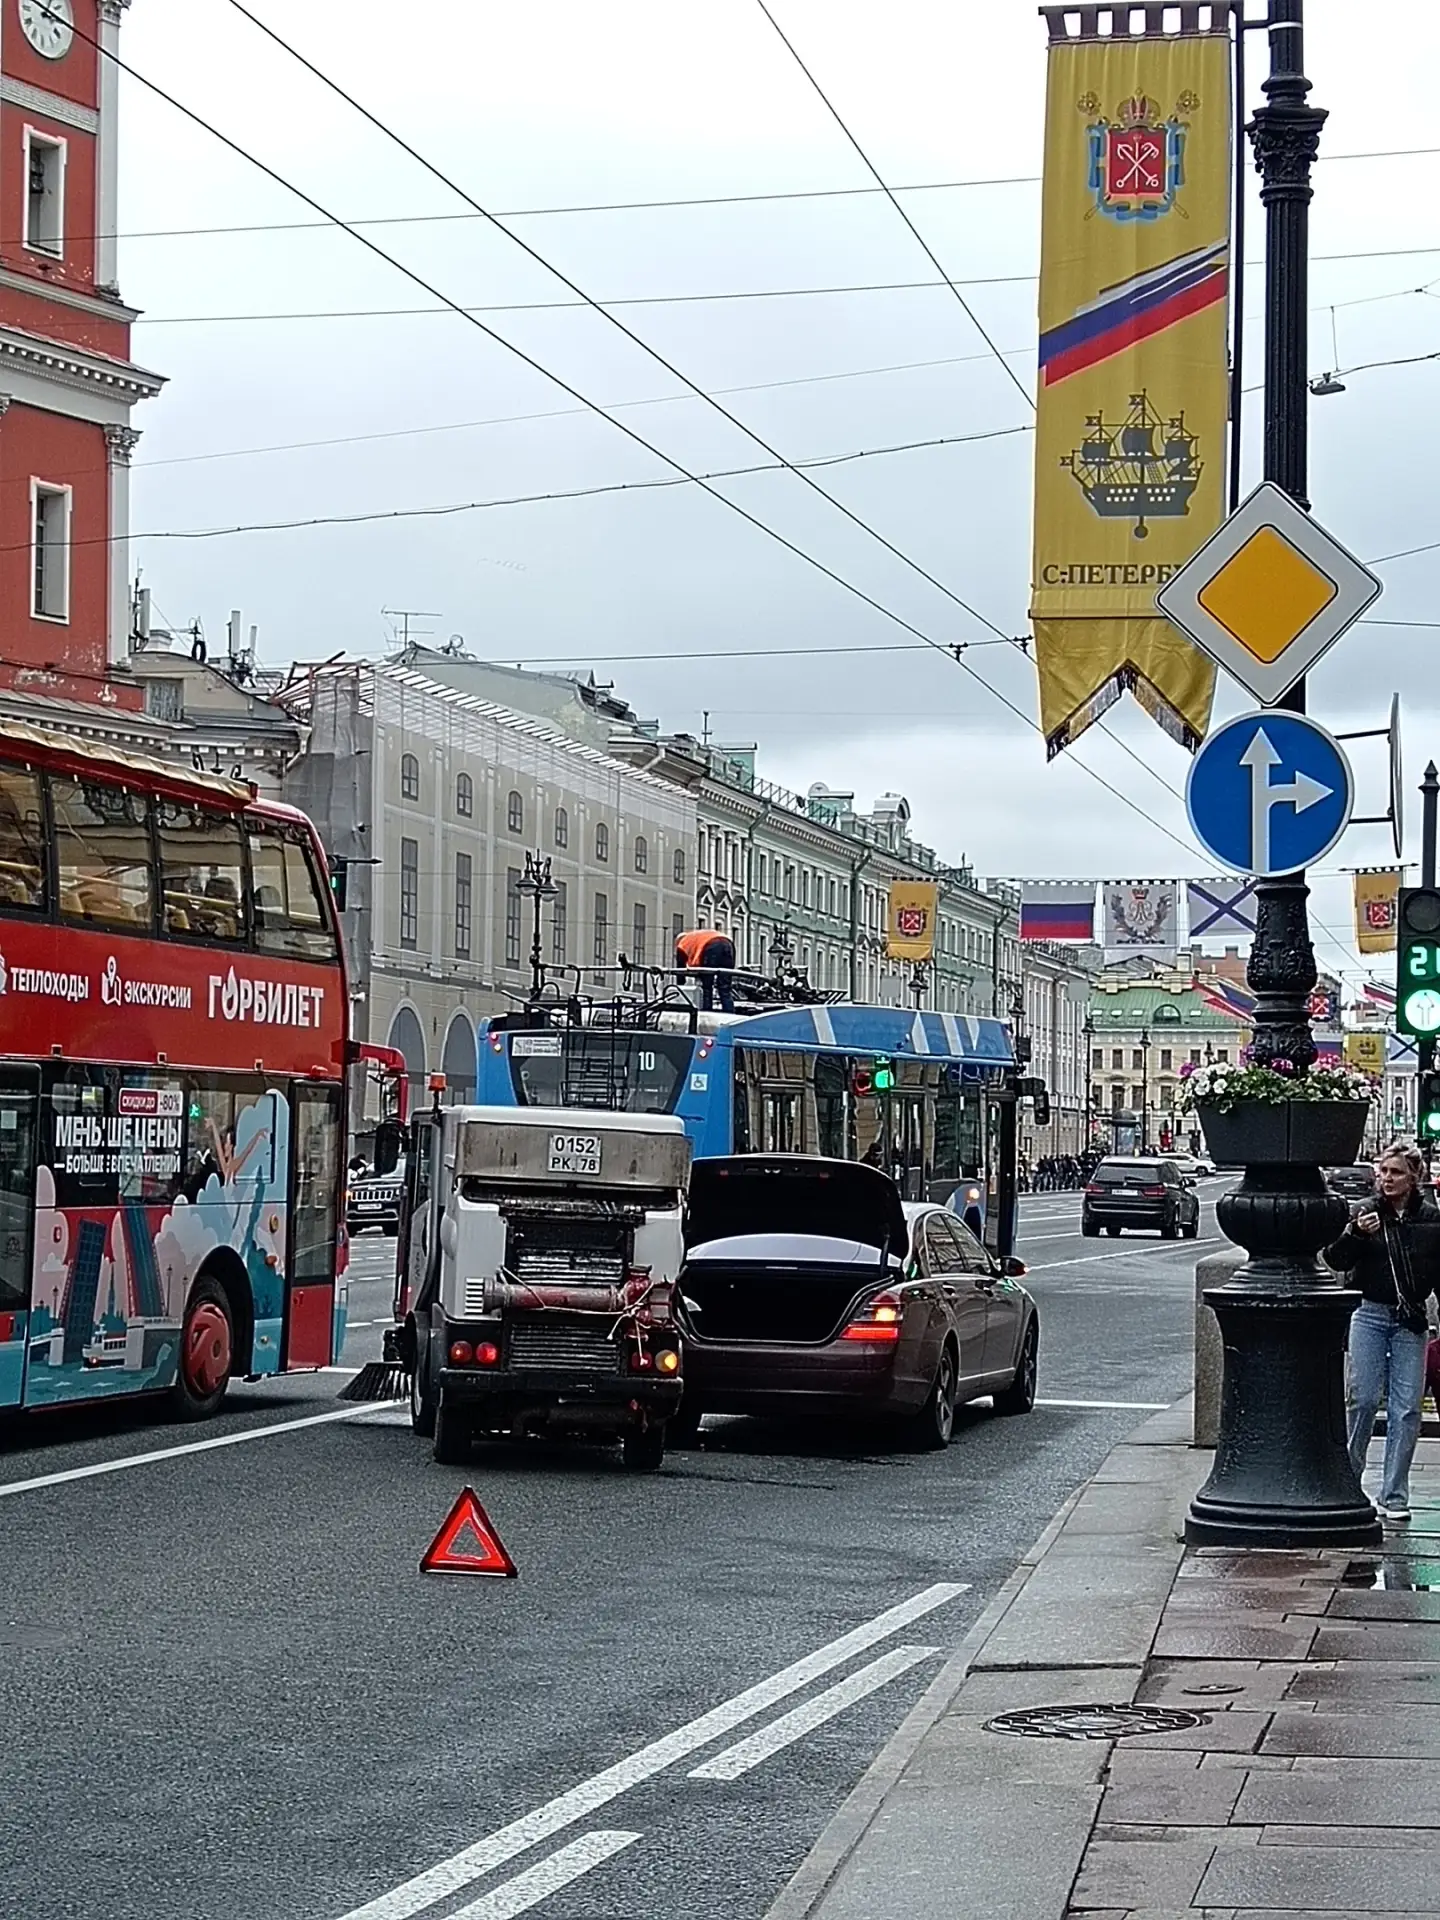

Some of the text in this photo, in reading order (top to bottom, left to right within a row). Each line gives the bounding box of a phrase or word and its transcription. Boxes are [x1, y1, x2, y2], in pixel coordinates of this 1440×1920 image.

[10, 967, 89, 1002] ТЕПЛОХОДЫ
[124, 980, 192, 1009] ЭКСКУРСИИ
[208, 966, 325, 1028] ГОРБИЛЕТ
[638, 1051, 655, 1071] 10
[135, 1117, 182, 1153] ЦЕНЫ
[555, 1136, 595, 1154] 0152
[581, 1158, 596, 1171] 78
